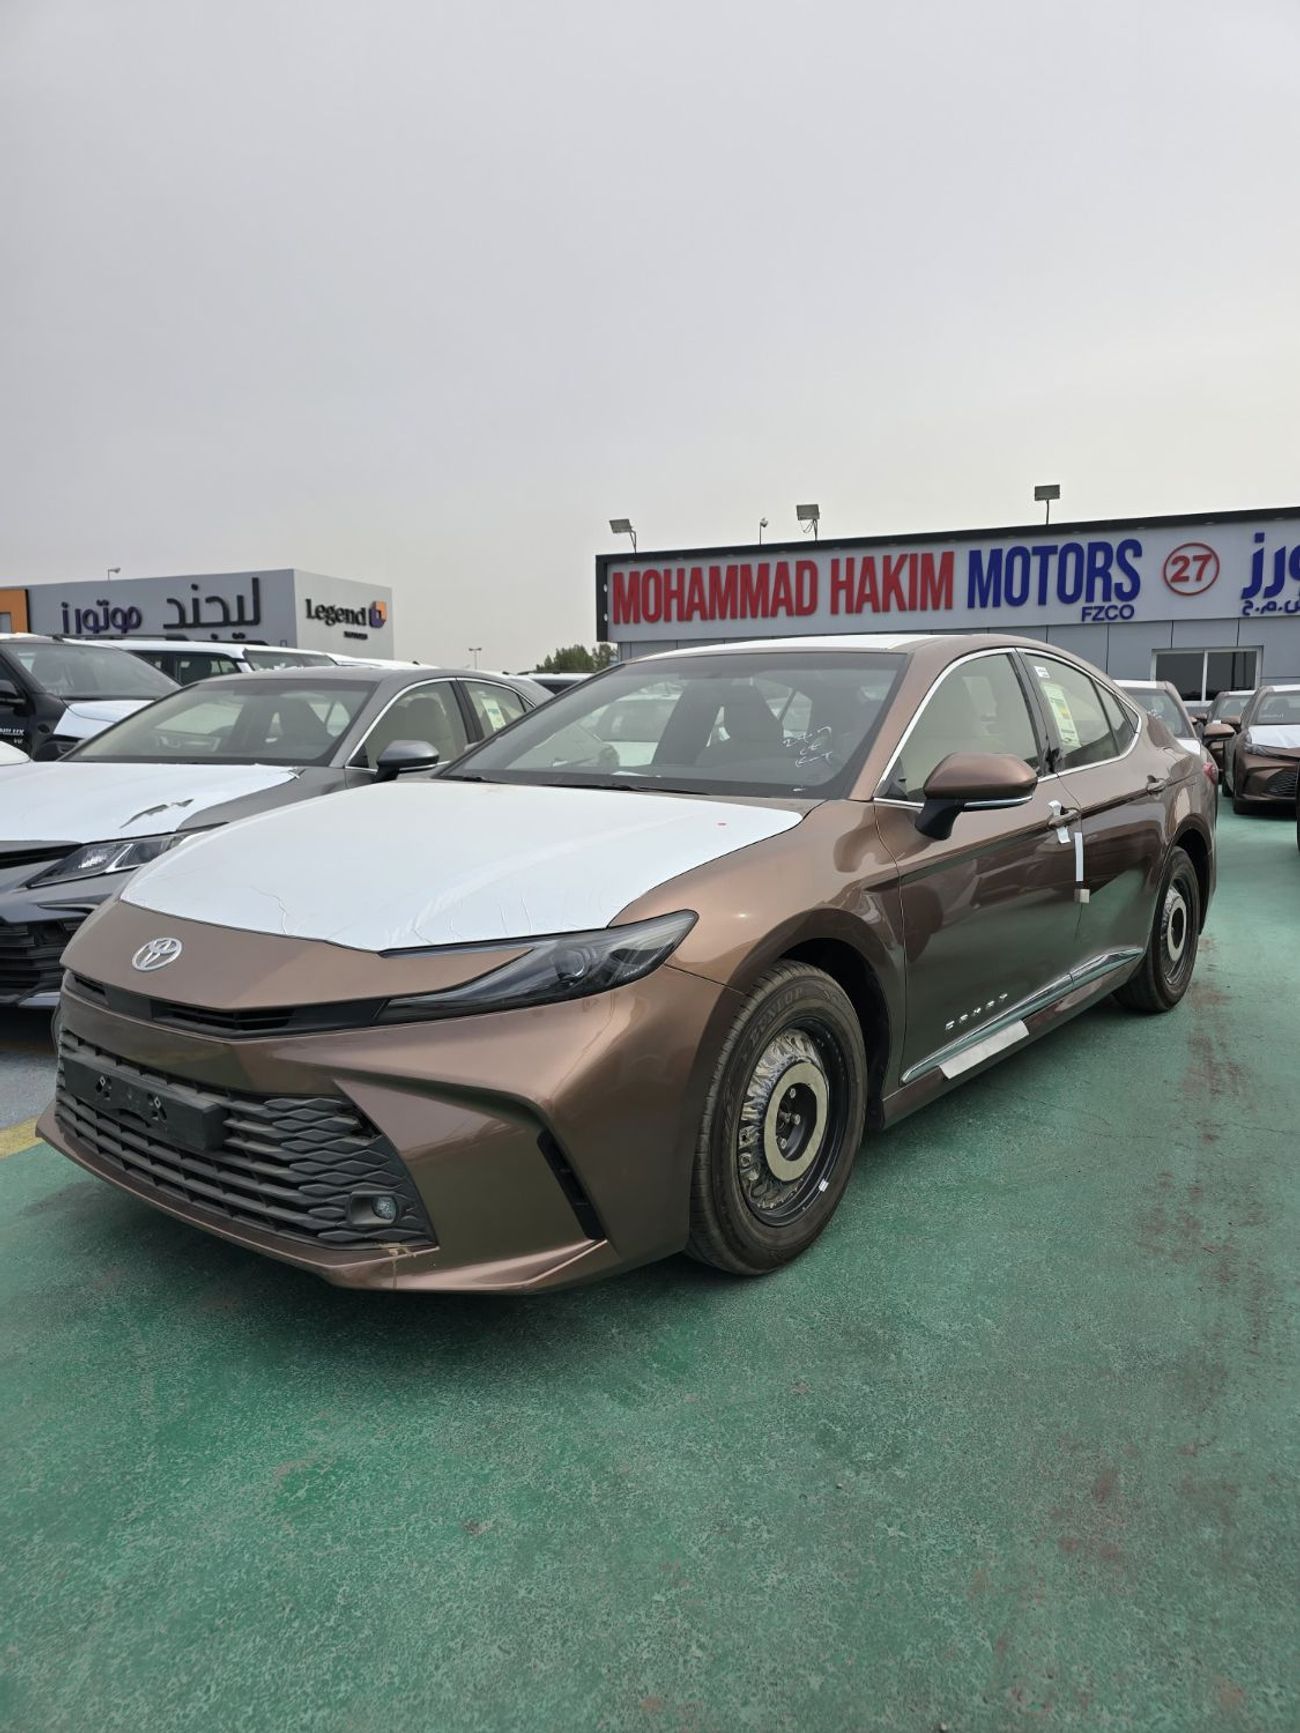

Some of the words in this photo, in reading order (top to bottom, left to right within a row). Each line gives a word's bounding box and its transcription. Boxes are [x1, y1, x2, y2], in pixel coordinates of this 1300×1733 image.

[612, 559, 818, 625] MOHAMMAD
[830, 551, 955, 615] HAKIM
[967, 539, 1143, 609] MOTORS
[1169, 553, 1213, 583] 27
[163, 577, 261, 640] ليجند
[305, 598, 367, 627] Legend
[1081, 604, 1135, 622] FZCO
